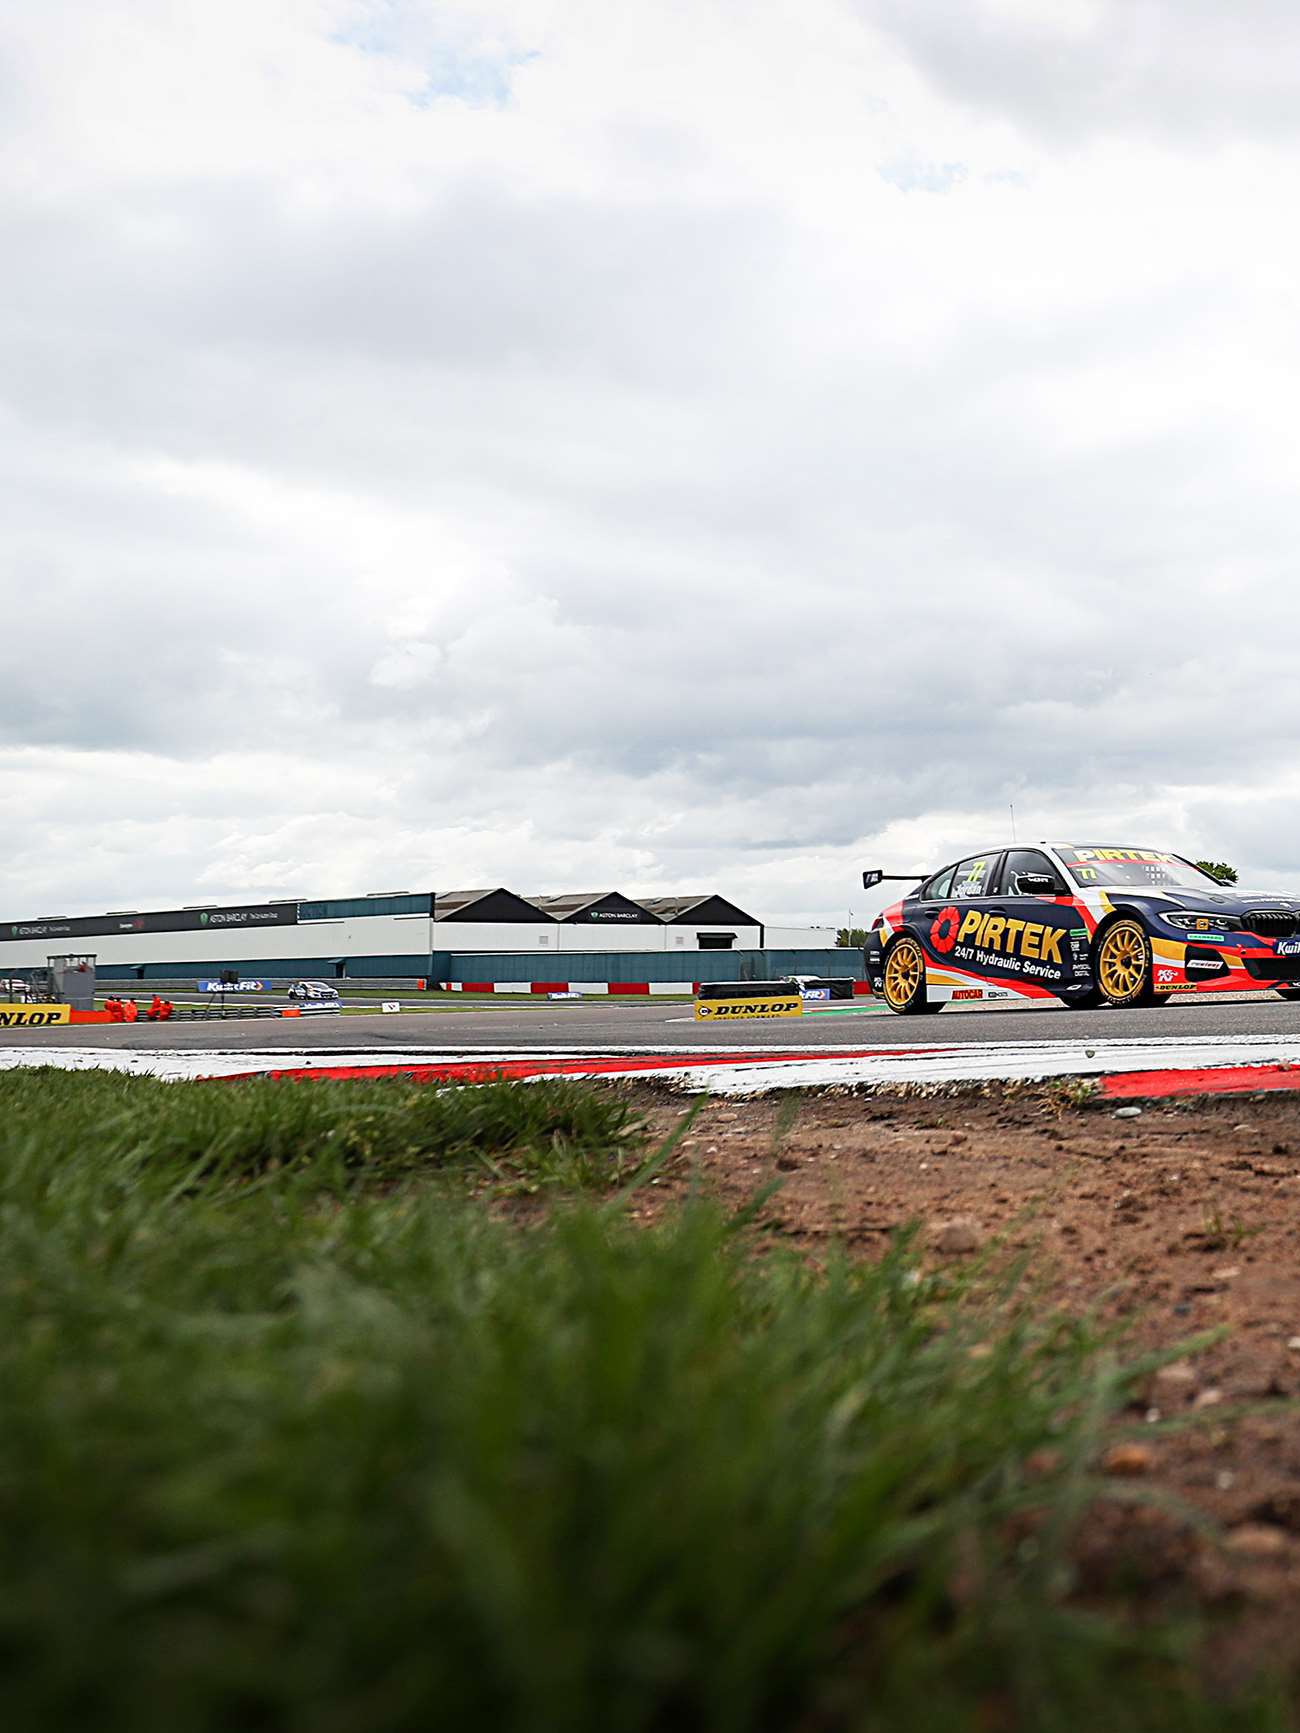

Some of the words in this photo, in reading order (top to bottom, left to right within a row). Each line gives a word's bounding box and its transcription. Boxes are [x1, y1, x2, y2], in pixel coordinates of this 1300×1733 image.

[1073, 848, 1173, 864] PIRTEK
[970, 861, 985, 882] 77
[1076, 868, 1098, 880] 77
[956, 909, 1067, 964] PIRTEK
[954, 945, 975, 960] 24/7
[975, 949, 1022, 971] Hydraulic
[1022, 960, 1062, 980] Service
[714, 1003, 798, 1016] DUNLOP
[0, 1012, 62, 1026] NLOP
